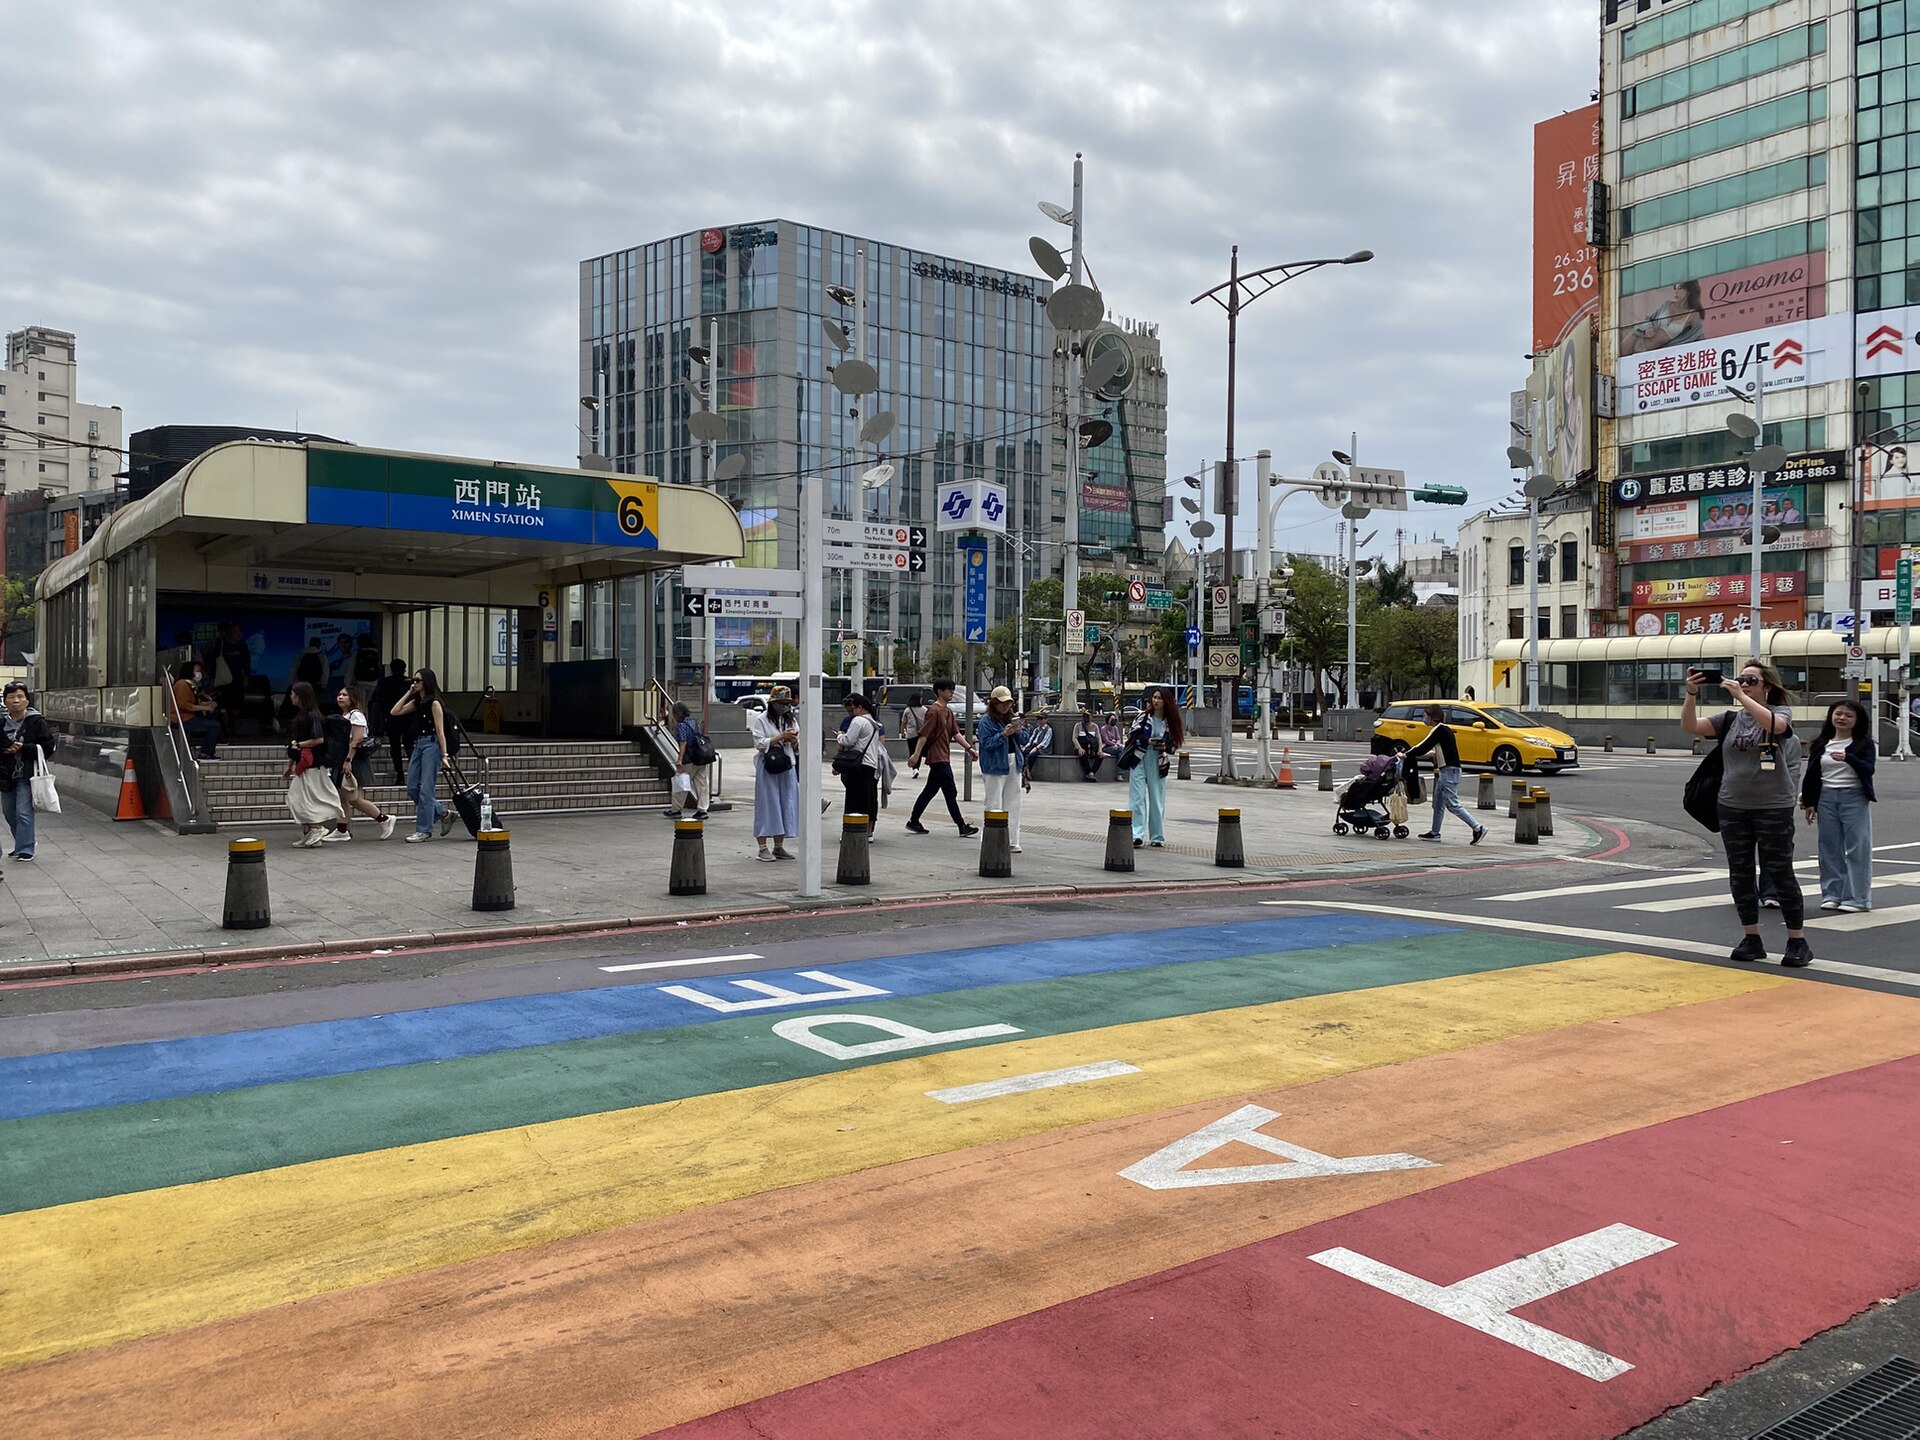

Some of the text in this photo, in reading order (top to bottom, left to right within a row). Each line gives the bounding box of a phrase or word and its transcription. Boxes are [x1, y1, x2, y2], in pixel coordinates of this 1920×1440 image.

[917, 262, 975, 287] GRAND
[1638, 348, 1717, 381] 密室逃脫
[1638, 370, 1717, 399] ESCAPE GAME
[1785, 457, 1825, 470] DrPlus
[1775, 466, 1837, 482] 2388-8863
[453, 478, 542, 511] 西門站
[451, 509, 544, 527] XIMEN STATION
[617, 495, 646, 536] 6
[827, 526, 841, 535] 70m
[827, 552, 844, 561] 300m
[1636, 584, 1652, 595] 3F
[538, 591, 549, 608] 6
[1501, 667, 1511, 688] 1
